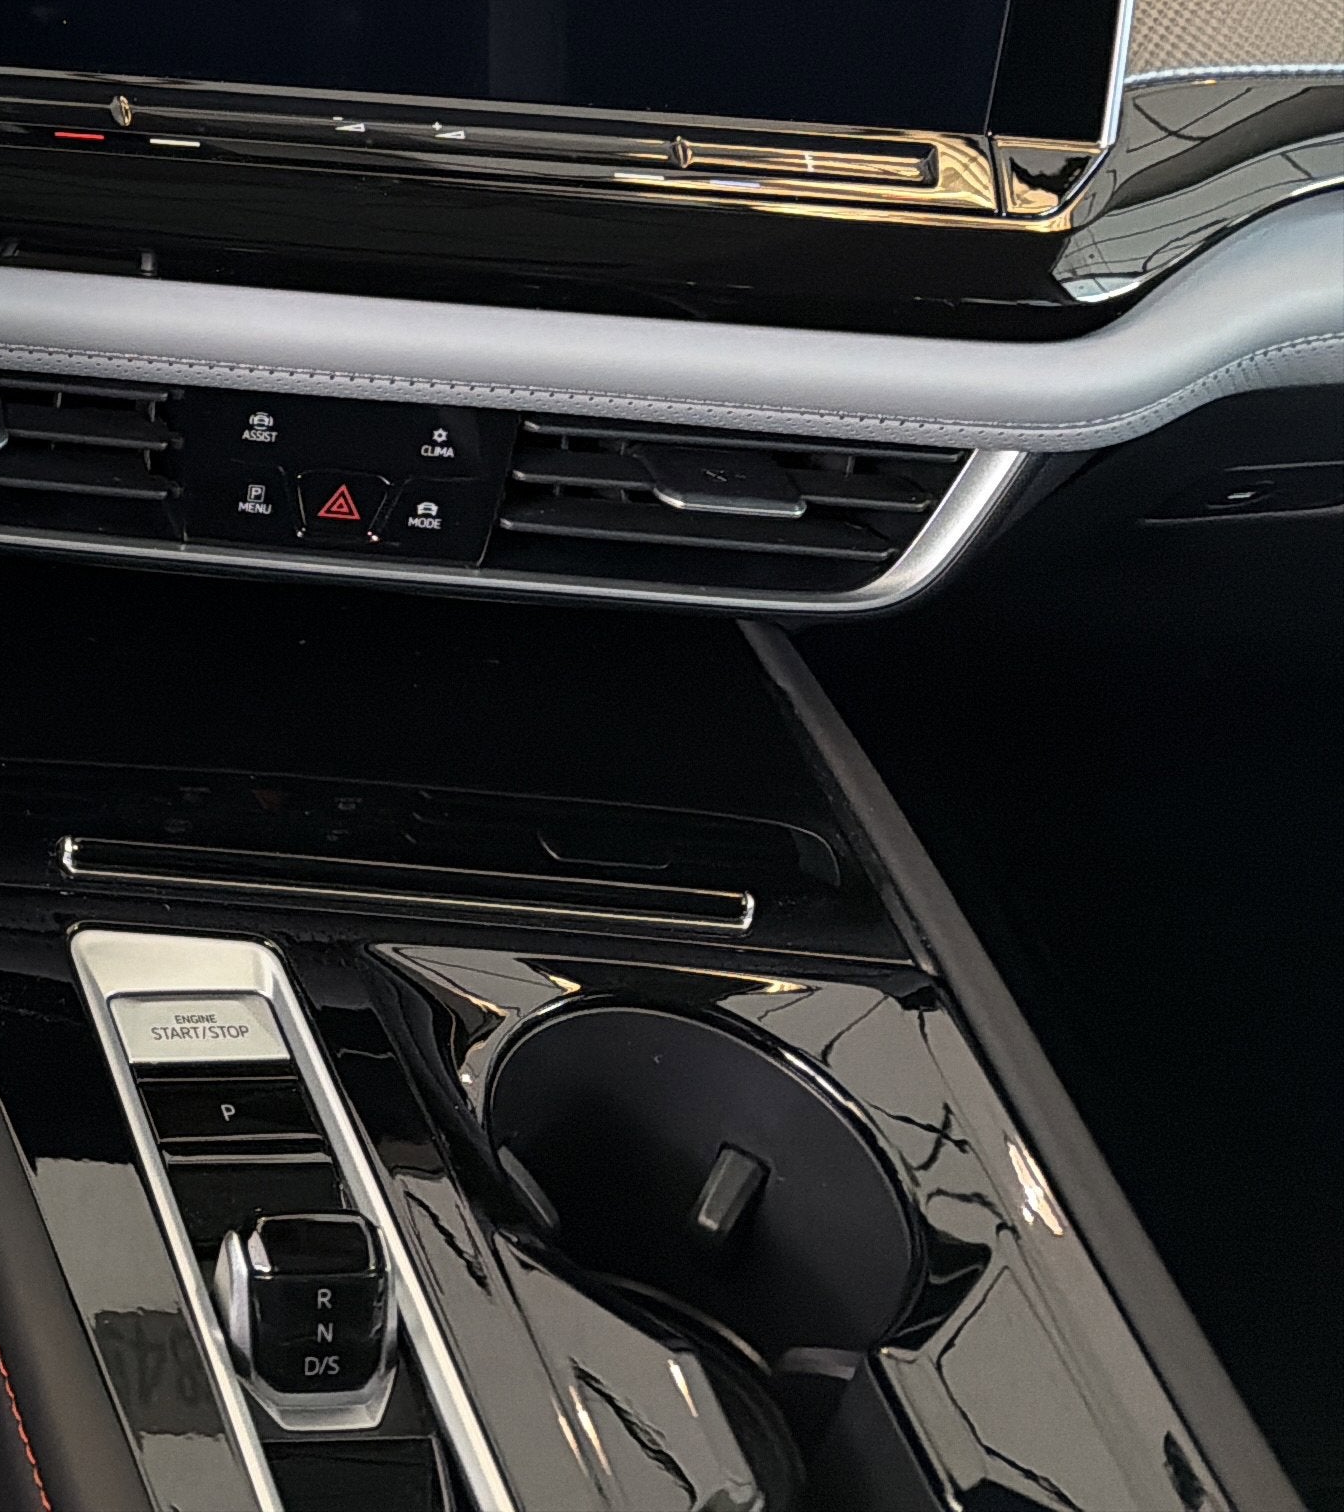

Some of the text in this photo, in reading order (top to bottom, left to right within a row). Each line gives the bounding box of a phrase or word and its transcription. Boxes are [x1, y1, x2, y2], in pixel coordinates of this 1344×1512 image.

[242, 429, 278, 443] ASSIST
[421, 444, 455, 458] CLIMA
[238, 501, 273, 516] MENU
[408, 516, 442, 530] MODE
[174, 1014, 218, 1025] ENGINE
[151, 1025, 250, 1042] START/STOP
[221, 1104, 236, 1122] P
[317, 1288, 332, 1309] R
[317, 1323, 334, 1343] N
[304, 1355, 340, 1376] D/S
